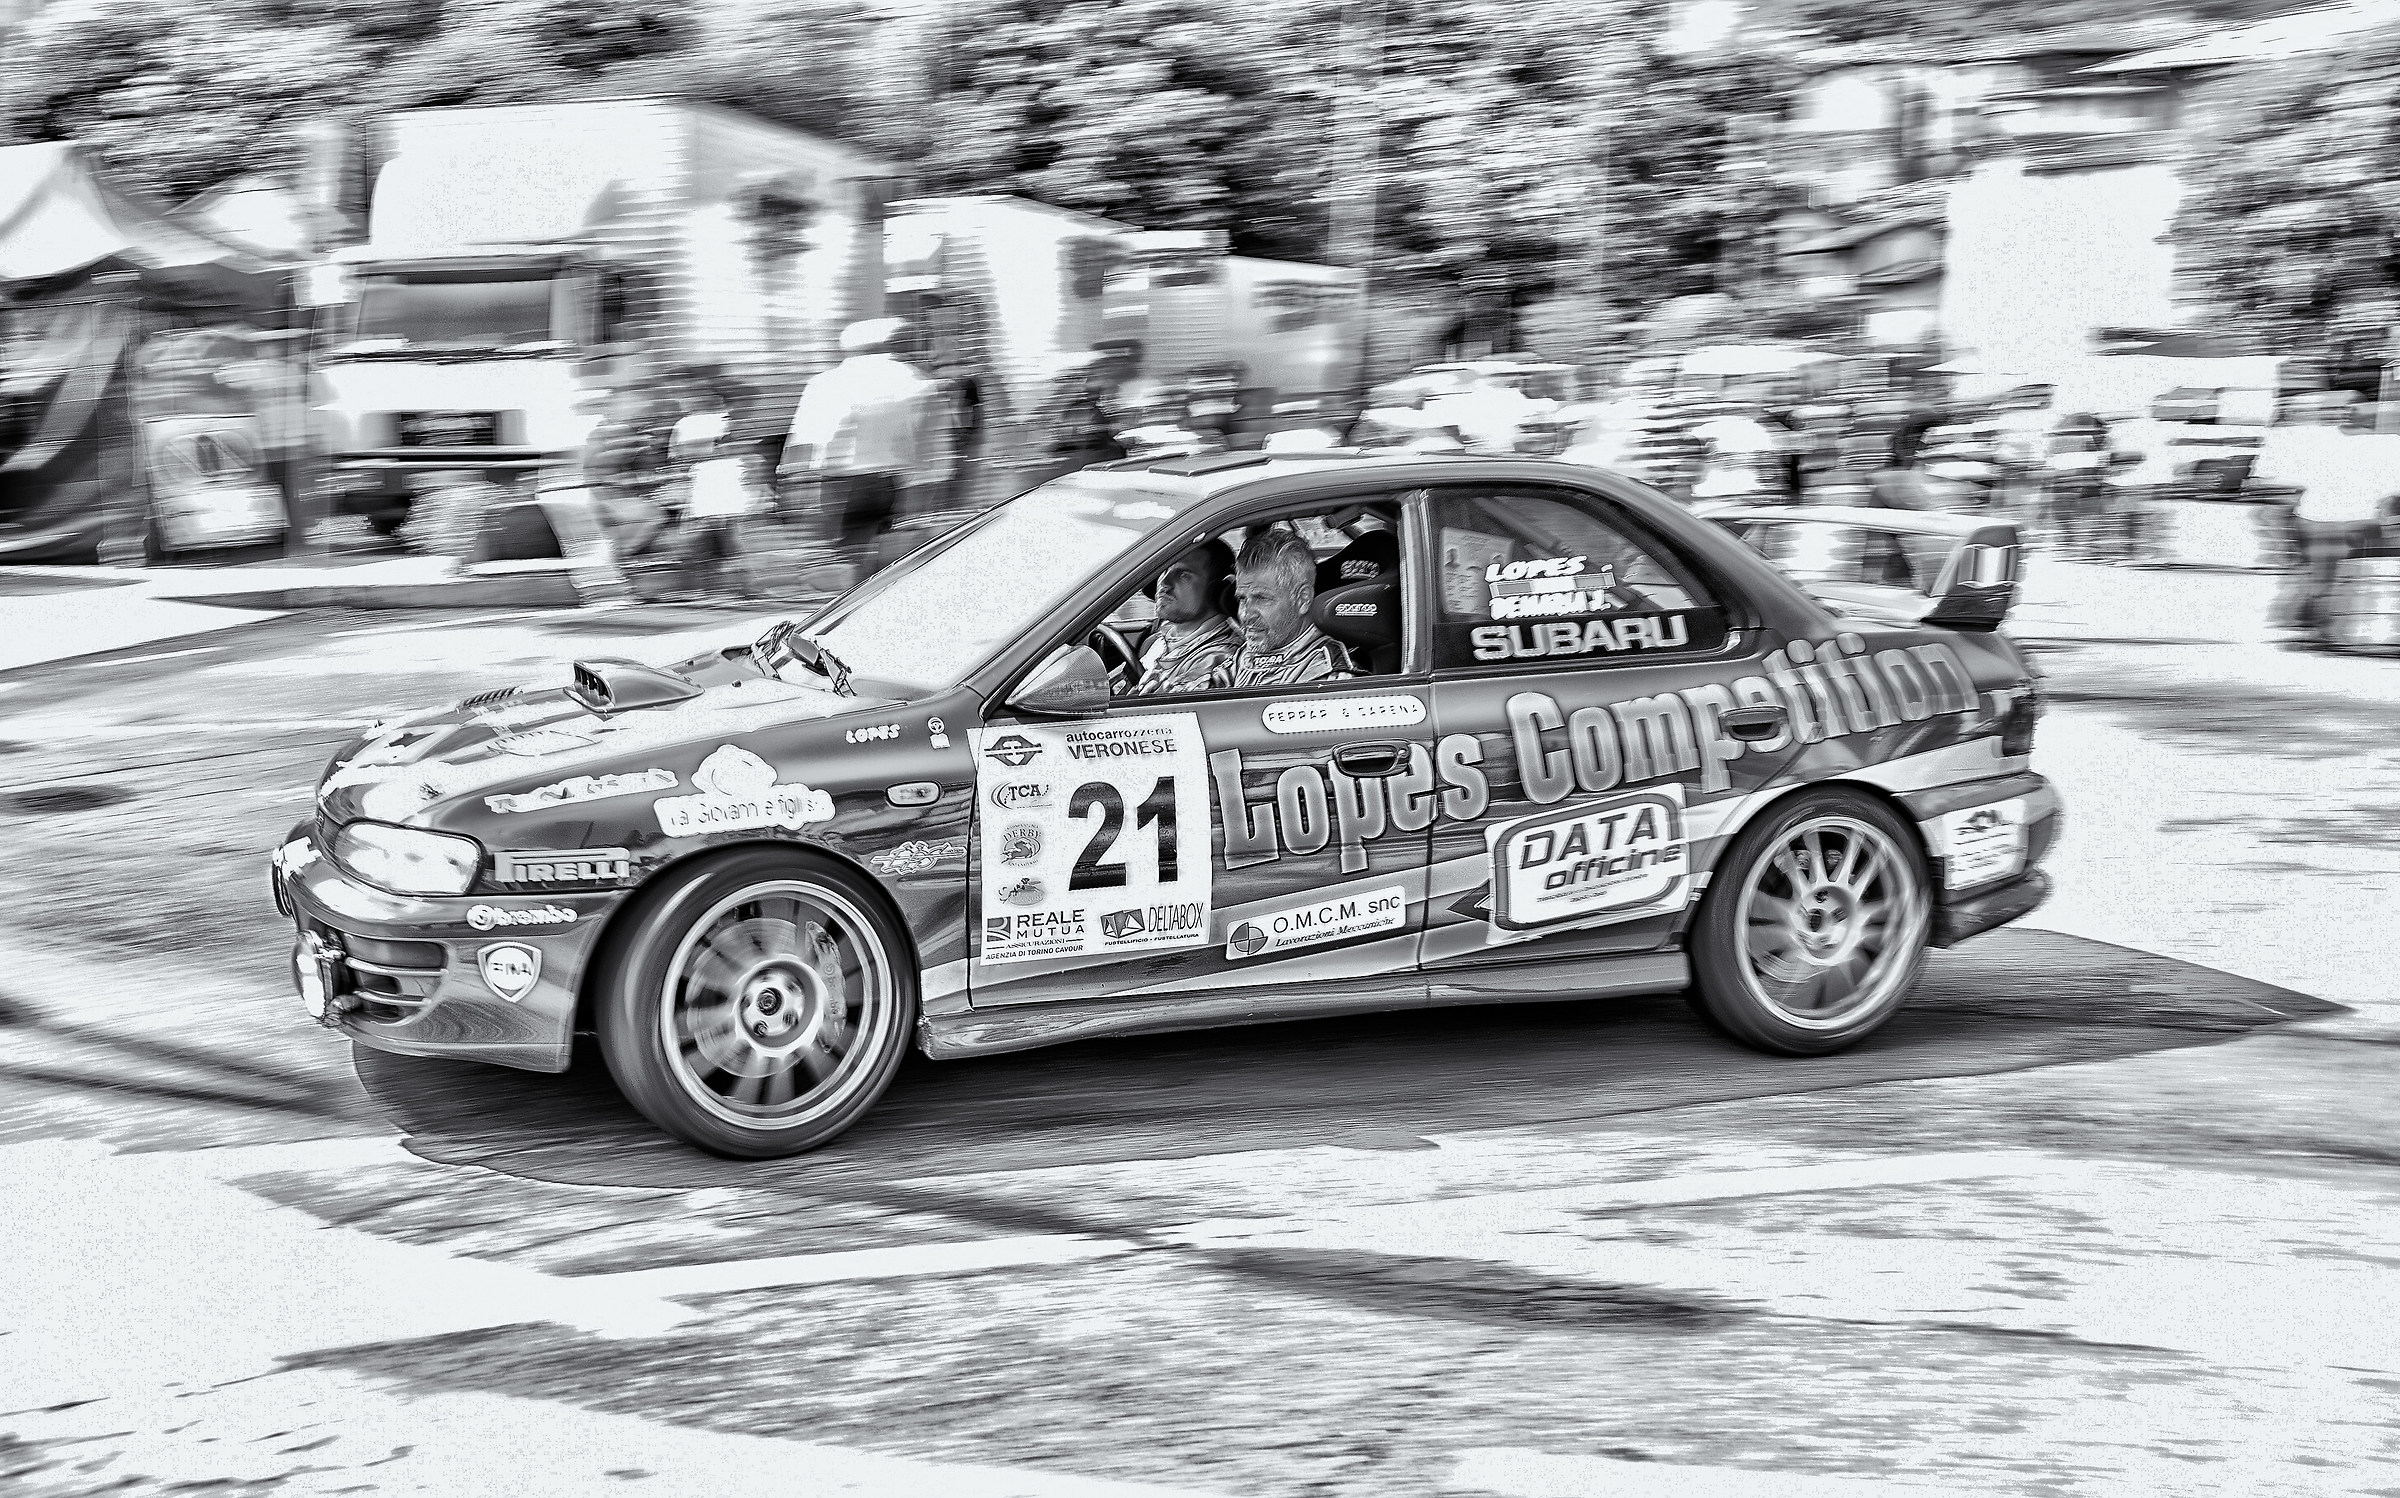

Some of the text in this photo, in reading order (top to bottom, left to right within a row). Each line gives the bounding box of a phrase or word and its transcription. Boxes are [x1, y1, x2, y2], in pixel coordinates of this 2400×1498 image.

[1485, 555, 1587, 582] LOPES
[1470, 614, 1689, 660] SUBARU
[1507, 632, 1980, 804] Competition
[846, 724, 900, 744] LOPES
[1068, 738, 1177, 760] VERONESE
[1008, 783, 1041, 801] TCA
[1209, 733, 1490, 874] Lopes
[1069, 776, 1178, 891] 21
[1519, 807, 1659, 869] DATA
[494, 847, 631, 883] PIRELLI
[1544, 845, 1681, 889] officine
[495, 904, 578, 926] brembo
[1017, 908, 1085, 928] REALE
[1149, 902, 1204, 933] DELTABOX
[1273, 896, 1401, 933] O.M.C.M. snc
[1005, 938, 1067, 950] ASSICURAZIONI
[1017, 924, 1085, 940] MUTUA
[1104, 937, 1149, 946] FUSTELLIFICIO
[1154, 933, 1200, 942] FUSTELLATURA
[1275, 929, 1336, 947] Lavorazioni
[985, 950, 1017, 960] AGENZIA
[1027, 947, 1055, 956] TORINO
[1055, 944, 1084, 954] CAVOUR
